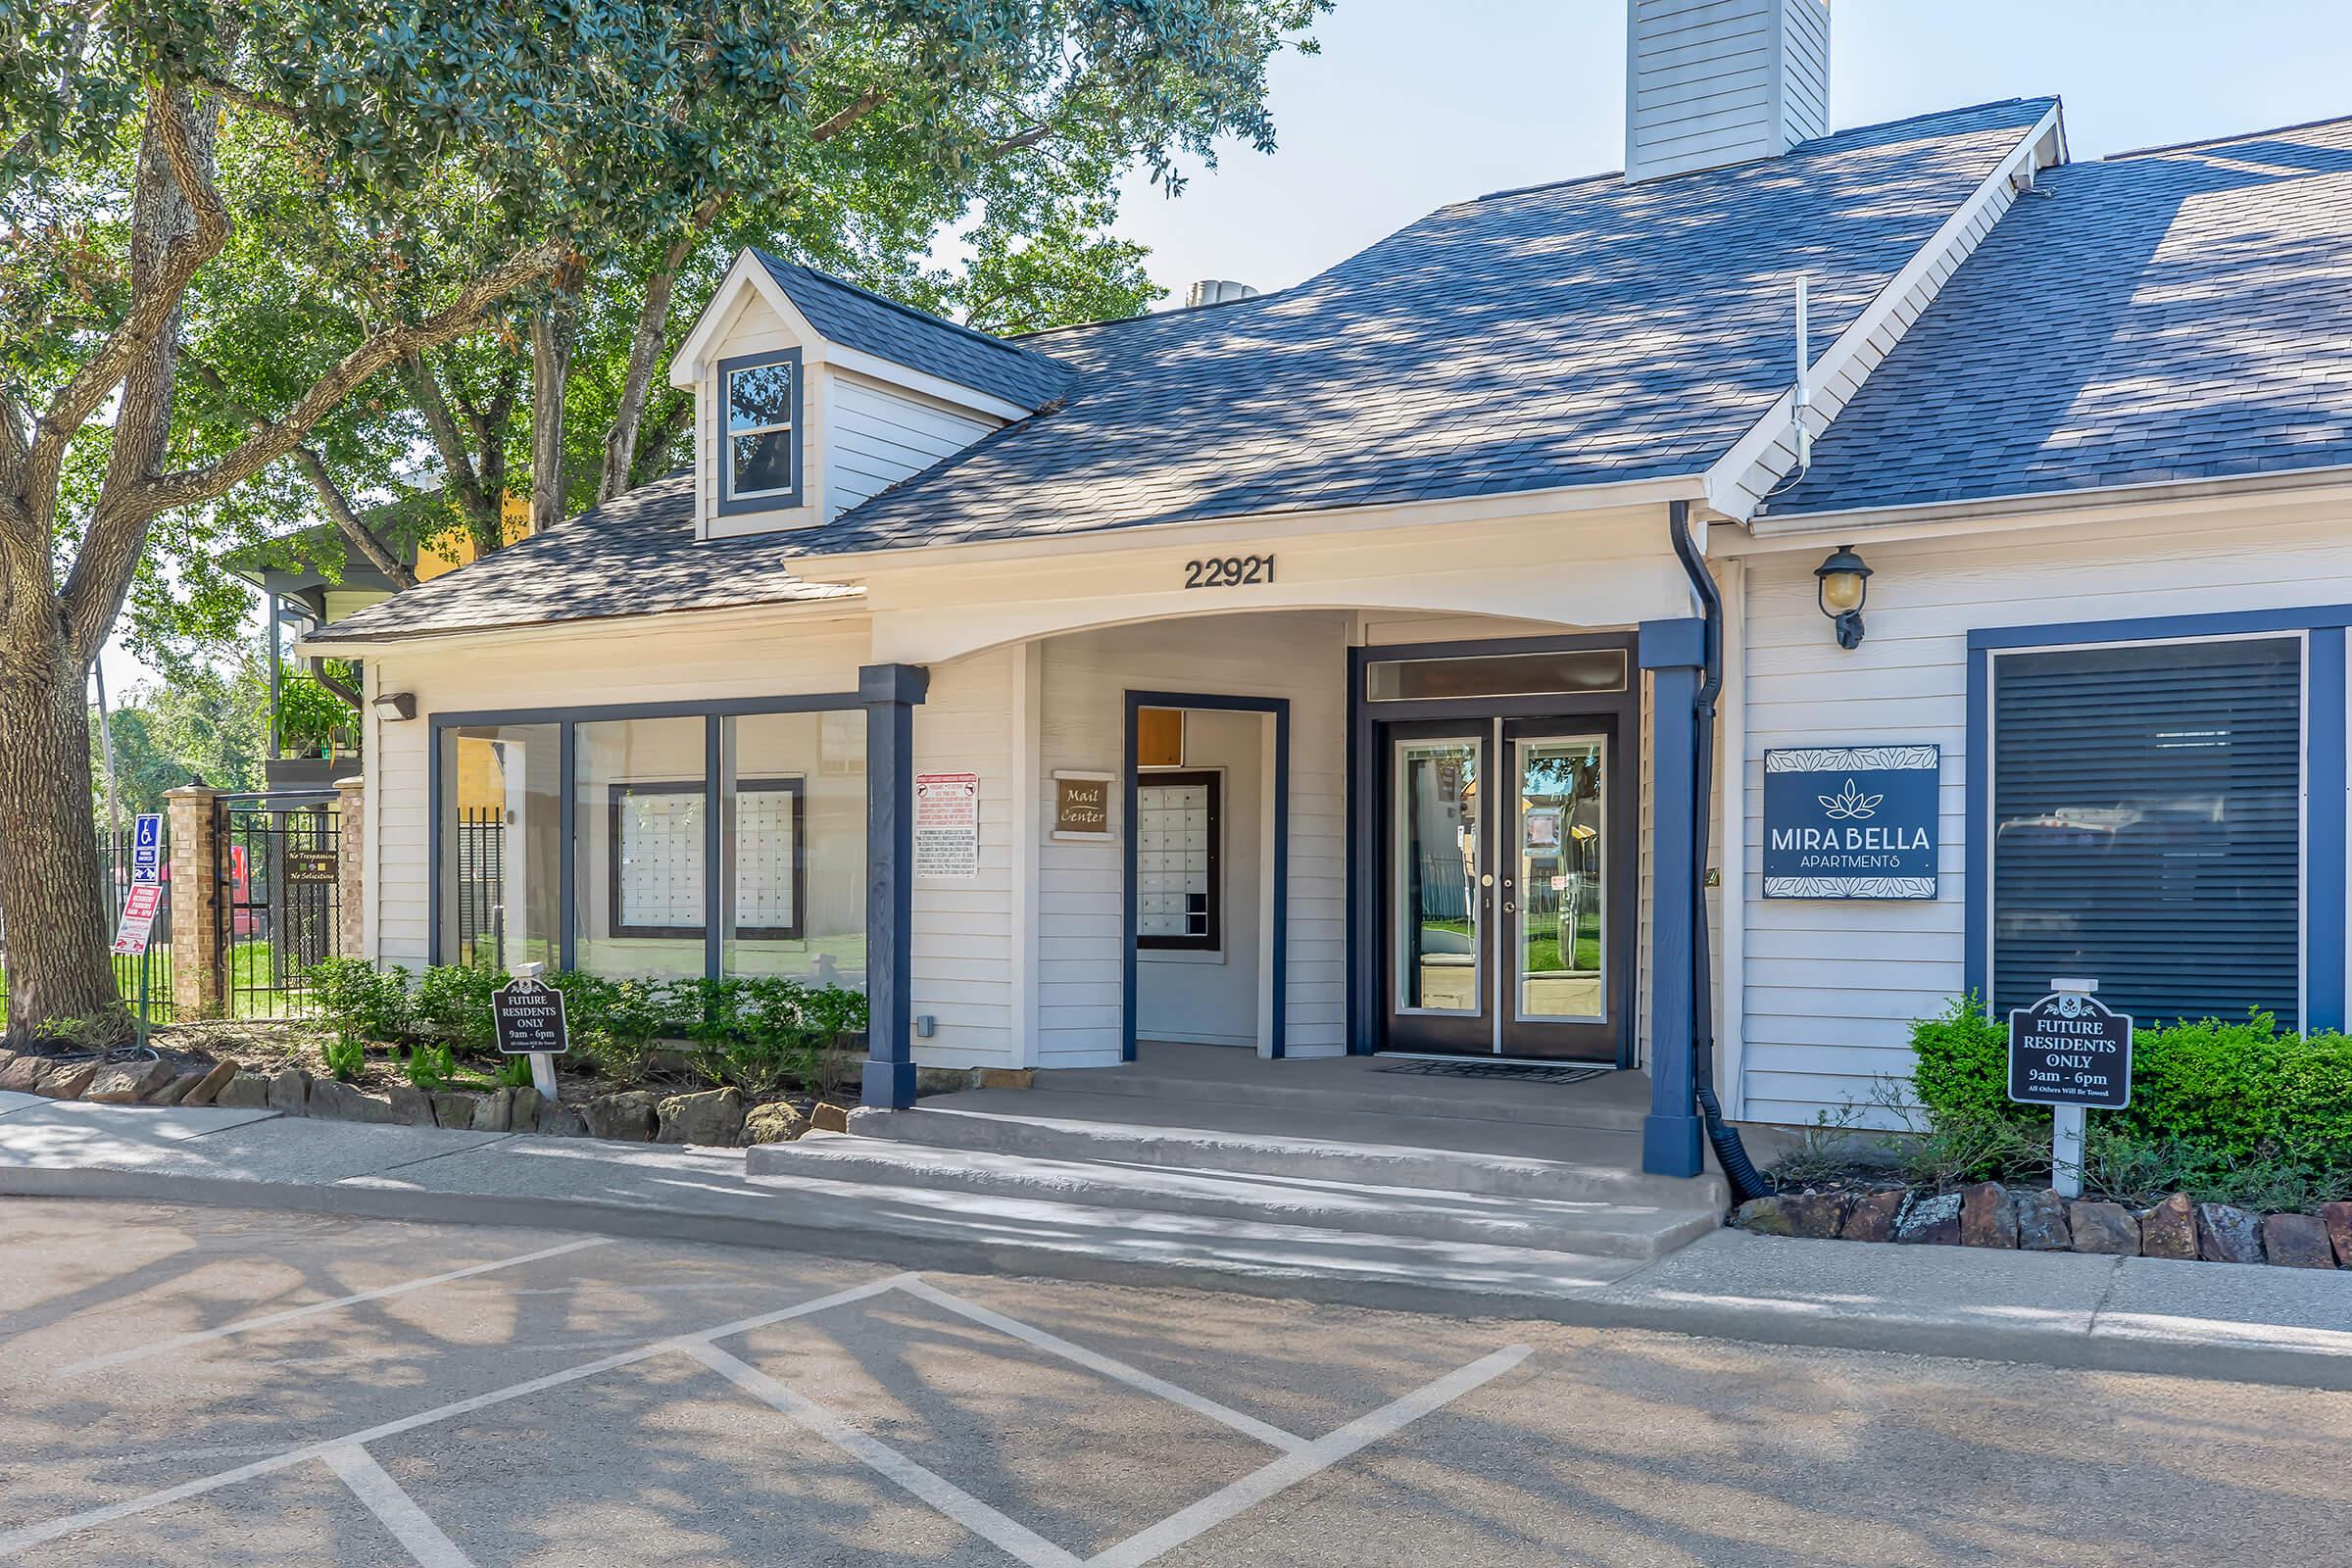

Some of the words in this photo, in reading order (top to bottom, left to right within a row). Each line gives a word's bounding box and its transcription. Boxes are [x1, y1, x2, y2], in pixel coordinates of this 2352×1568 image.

[1184, 554, 1275, 589] 22921
[1067, 789, 1098, 802] Mail
[1061, 809, 1105, 823] Center
[1772, 828, 1839, 851] MIRA
[1846, 827, 1930, 851] BELLA
[299, 853, 337, 862] Trespassing
[1800, 855, 1900, 868] APARTMENTS
[301, 872, 335, 882] Soliciting
[508, 995, 548, 1005] FUTURE
[502, 1007, 556, 1017] RESIDENTS
[517, 1019, 544, 1028] ONLY
[2037, 1020, 2104, 1035] FUTURE
[509, 1030, 528, 1038] 9am
[535, 1029, 555, 1040] 6pm
[2023, 1036, 2116, 1054] RESIDENTS
[2046, 1054, 2093, 1068] ONLY
[2029, 1069, 2060, 1082] 9am
[2075, 1072, 2108, 1087] 6pm
